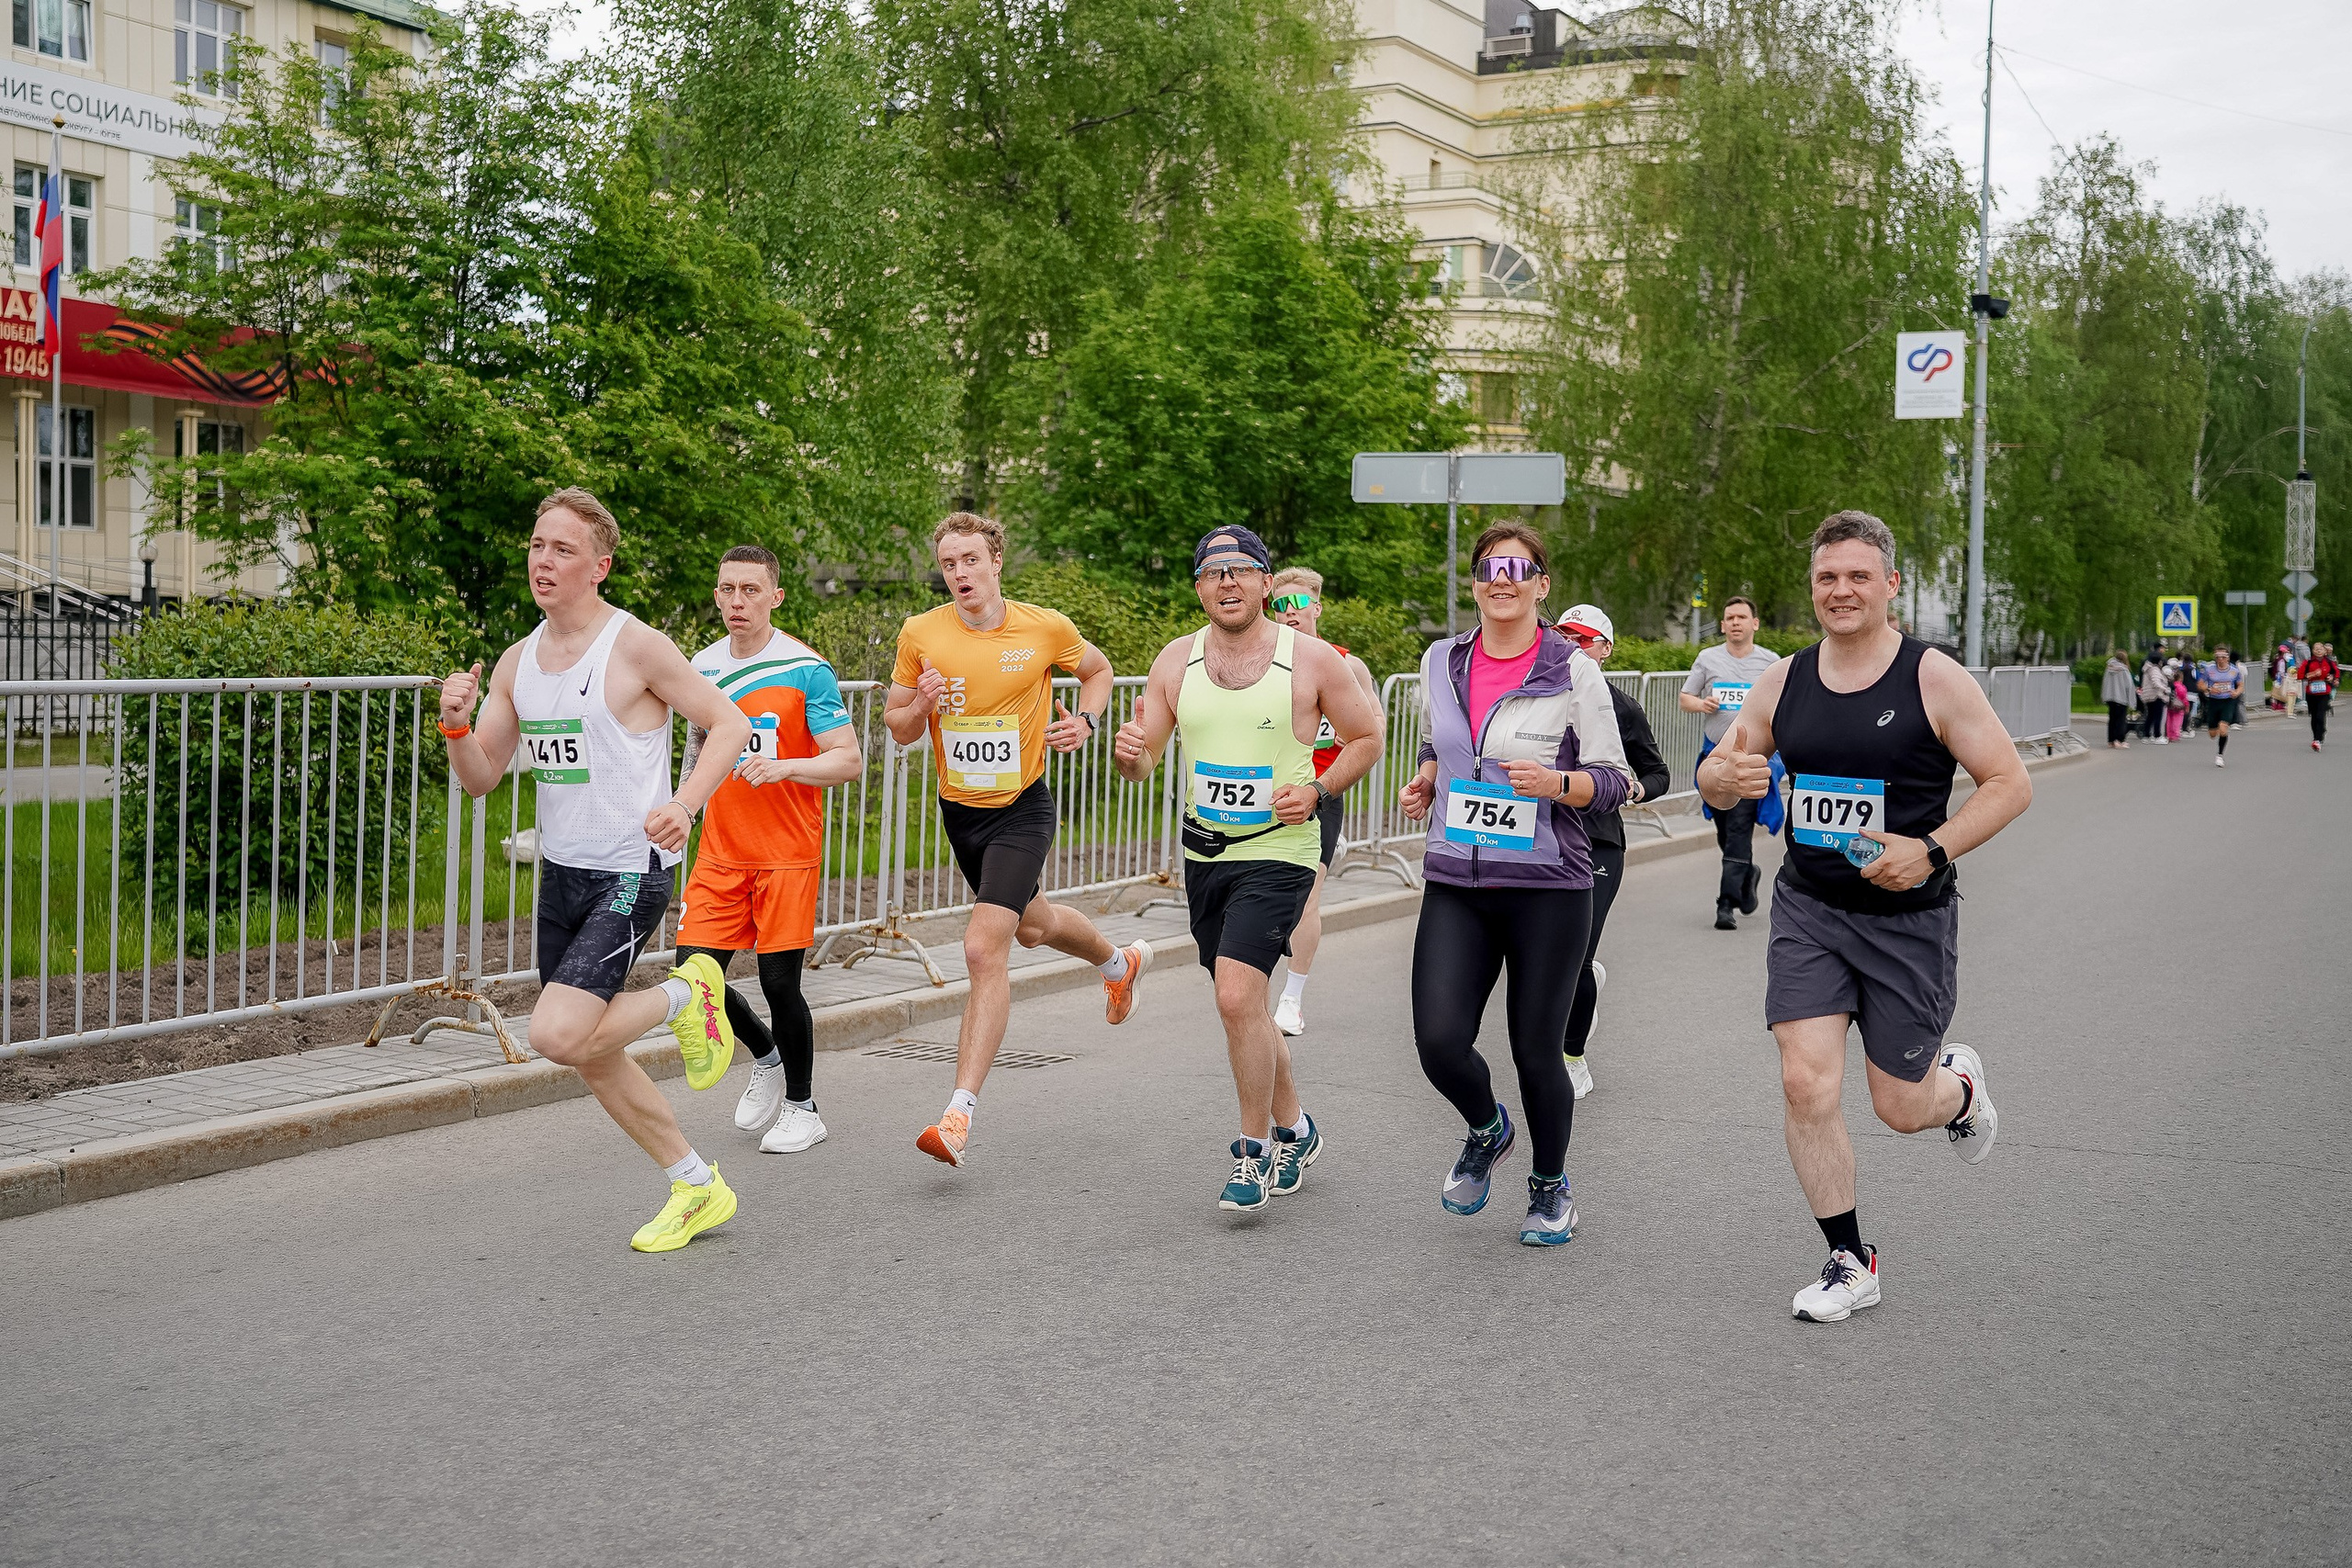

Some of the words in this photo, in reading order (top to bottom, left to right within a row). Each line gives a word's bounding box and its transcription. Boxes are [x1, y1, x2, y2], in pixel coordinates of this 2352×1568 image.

[1001, 664, 1023, 672] 2022
[1720, 691, 1744, 702] 755
[527, 739, 579, 763] 1415
[953, 740, 1011, 762] 4003
[1207, 781, 1255, 807] 752
[1464, 799, 1517, 830] 754
[1802, 795, 1873, 828] 1079
